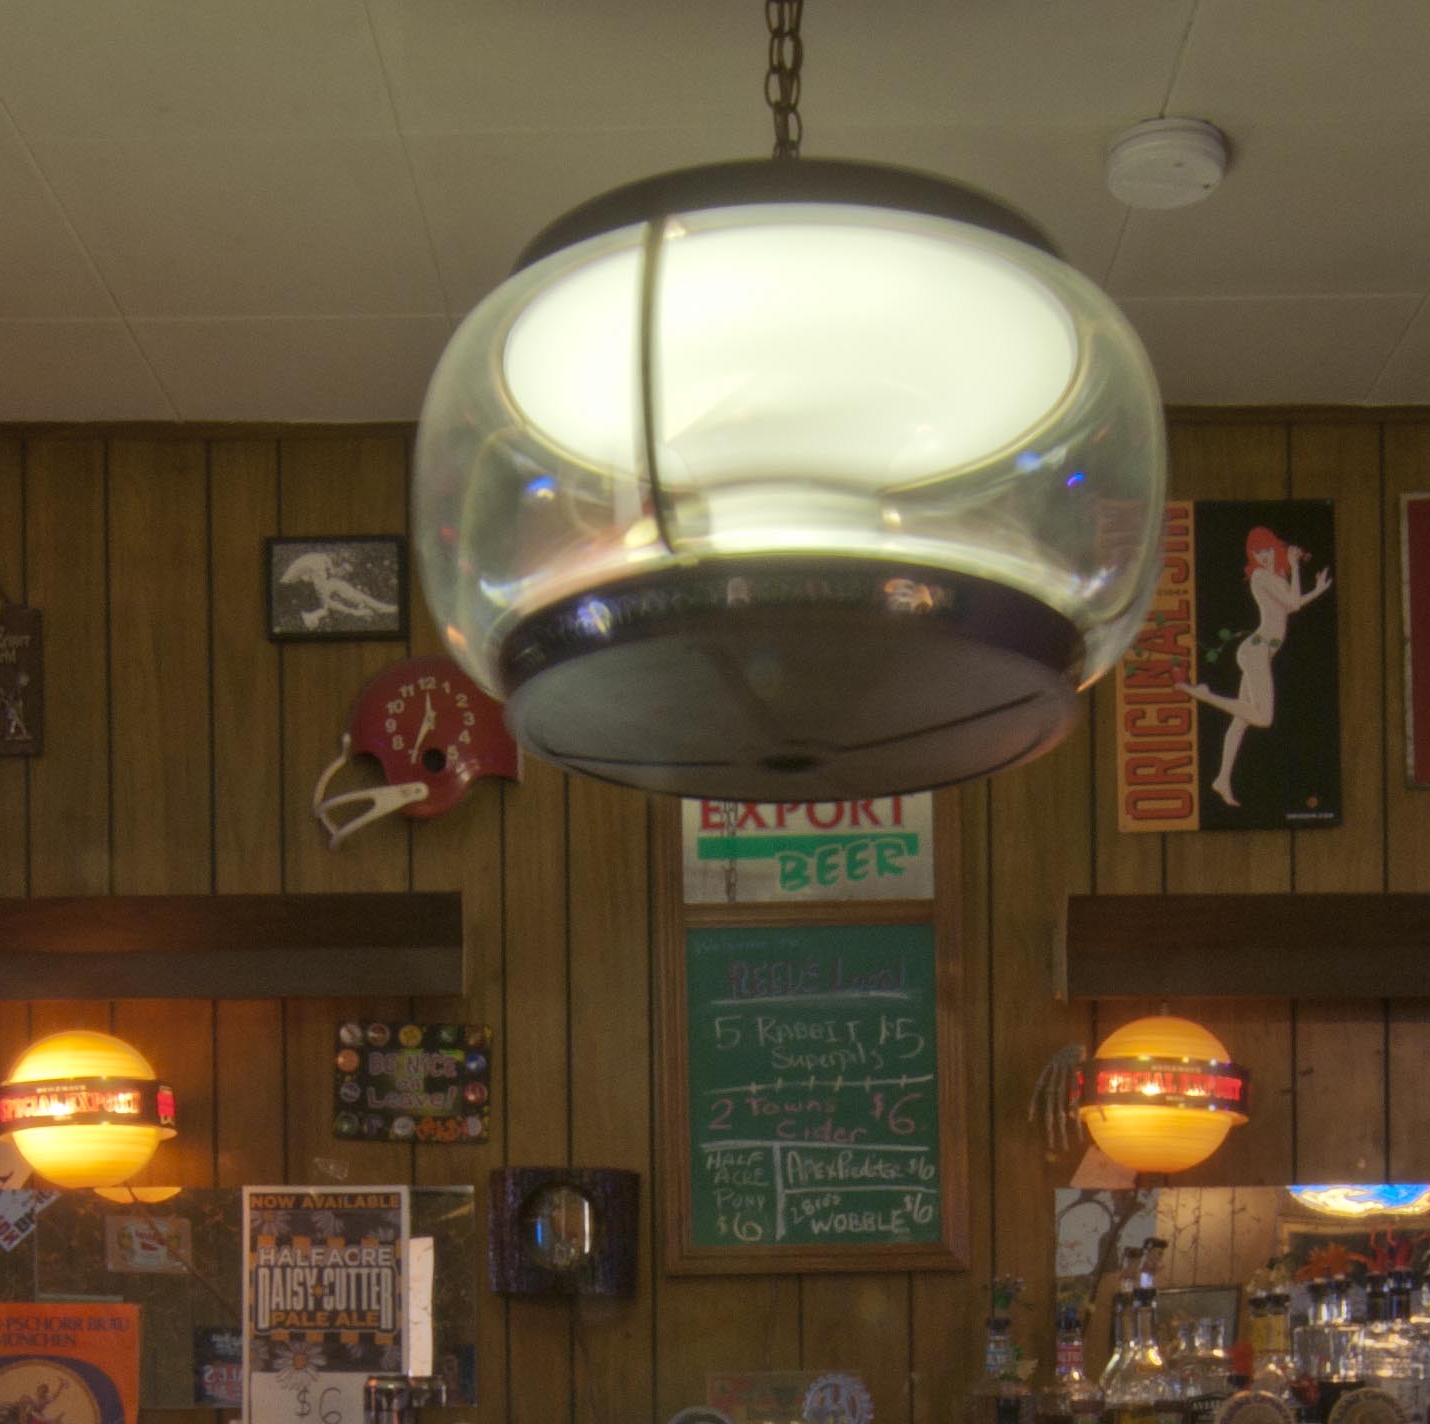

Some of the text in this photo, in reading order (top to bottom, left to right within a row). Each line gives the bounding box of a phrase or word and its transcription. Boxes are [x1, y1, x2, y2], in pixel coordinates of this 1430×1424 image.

[418, 676, 437, 690] 12
[442, 681, 451, 694] 1
[398, 684, 415, 698] 11
[386, 700, 405, 714] 10
[455, 693, 469, 708] 2
[385, 718, 397, 733] 9
[463, 711, 475, 726] 3
[392, 735, 404, 750] 8
[459, 729, 471, 745] 4
[777, 837, 907, 892] BEER
[713, 1015, 742, 1049] 5
[705, 1097, 735, 1131] 2
[251, 1194, 400, 1209] NOW AVAILABLE
[811, 1208, 911, 1236] WOBBLE
[256, 1266, 394, 1331] DAISY CUTTER
[271, 1311, 380, 1327] PALE ALE
